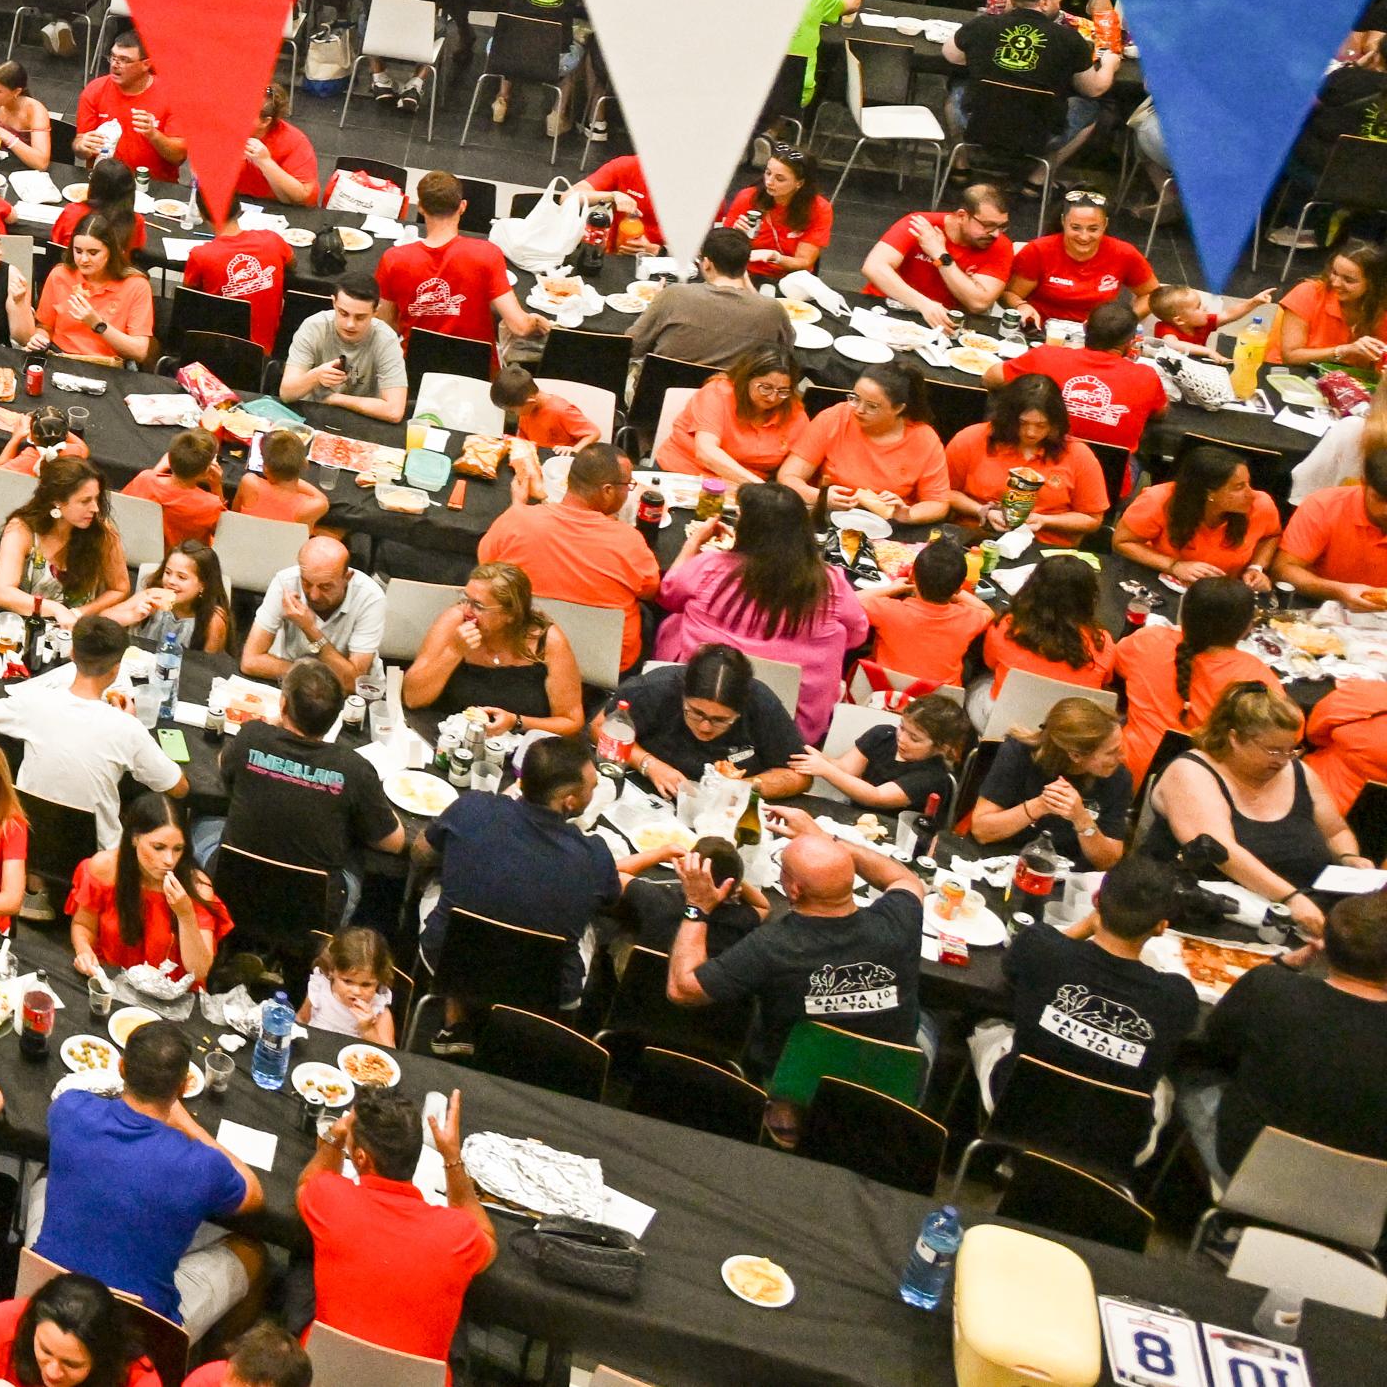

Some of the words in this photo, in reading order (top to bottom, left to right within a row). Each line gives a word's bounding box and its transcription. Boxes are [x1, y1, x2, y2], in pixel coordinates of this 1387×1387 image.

[1015, 37, 1026, 49] 3
[248, 748, 345, 786] TIMBERLAND
[814, 994, 861, 1005] GAIATA
[876, 990, 891, 999] 10
[850, 1002, 884, 1010] TOLL
[1052, 1014, 1109, 1045] GAIATA
[1058, 1026, 1074, 1040] EL
[1087, 1039, 1123, 1060] TOLL
[1132, 1329, 1176, 1376] 8
